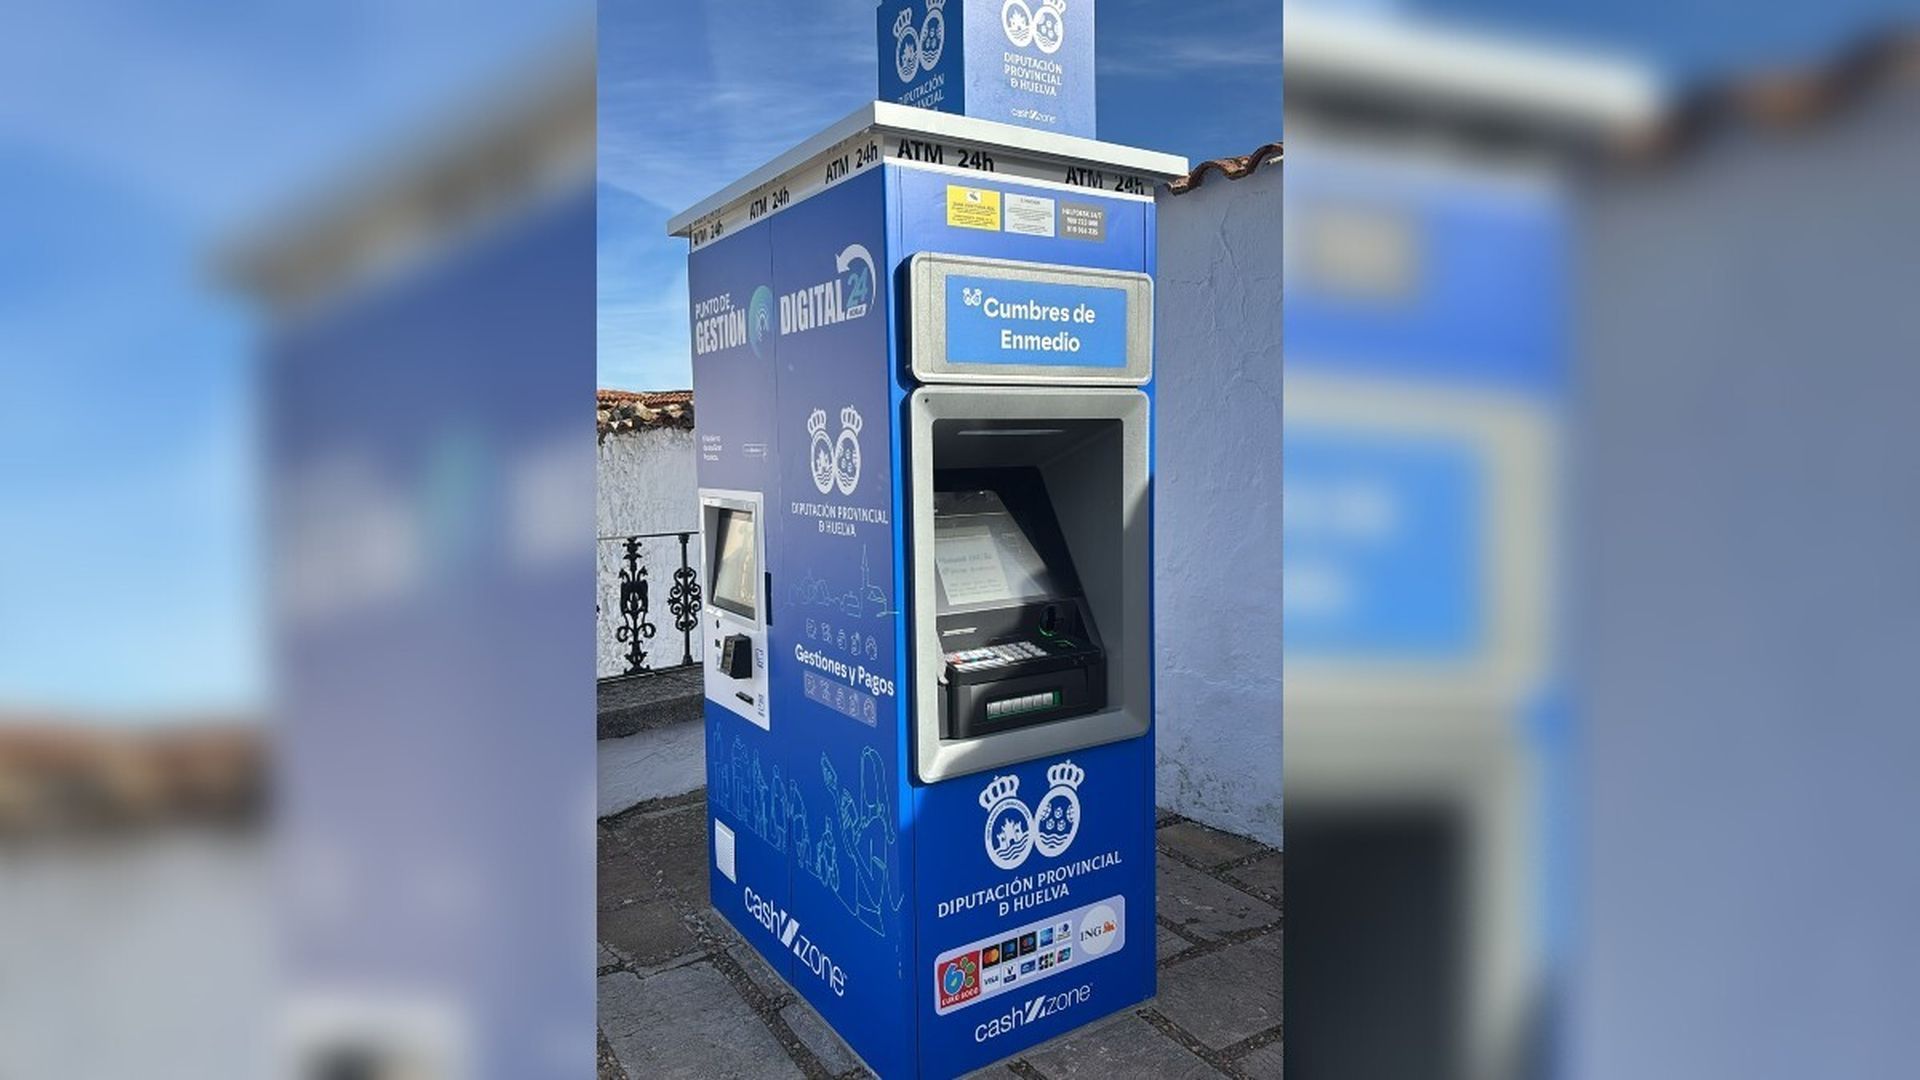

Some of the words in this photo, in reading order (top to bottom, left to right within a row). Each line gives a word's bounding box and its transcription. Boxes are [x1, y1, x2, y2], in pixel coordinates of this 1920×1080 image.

[1003, 52, 1063, 74] DIPUTACIÓN
[1004, 64, 1062, 86] PROVINCIAL
[1019, 79, 1057, 97] HUELVA
[825, 154, 849, 184] ATM
[856, 141, 878, 169] 24h
[896, 138, 944, 165] ATM
[957, 149, 995, 173] 24h
[1065, 166, 1103, 189] ATM
[1114, 175, 1145, 195] 24h
[750, 196, 768, 220] ATM
[772, 186, 790, 210] 24h
[695, 296, 720, 320] PUNTO
[720, 293, 731, 312] DE
[780, 279, 846, 335] DIGITAL
[846, 266, 869, 308] 24
[983, 297, 1070, 322] Cumbres
[1073, 303, 1096, 324] de
[695, 304, 747, 355] GESTIÓN
[1000, 330, 1080, 352] Enmedio
[791, 502, 836, 518] DIPUTACIÓN
[837, 505, 889, 524] PROVINCIAL
[825, 522, 857, 537] HUELVA
[794, 644, 848, 678] Gestiones
[849, 666, 857, 686] y
[858, 665, 895, 697] Pagos
[937, 876, 1034, 918] DIPUTACIÓN
[1037, 850, 1123, 888] PROVINCIAL
[1013, 882, 1070, 912] HUELVA
[1080, 926, 1102, 942] ING
